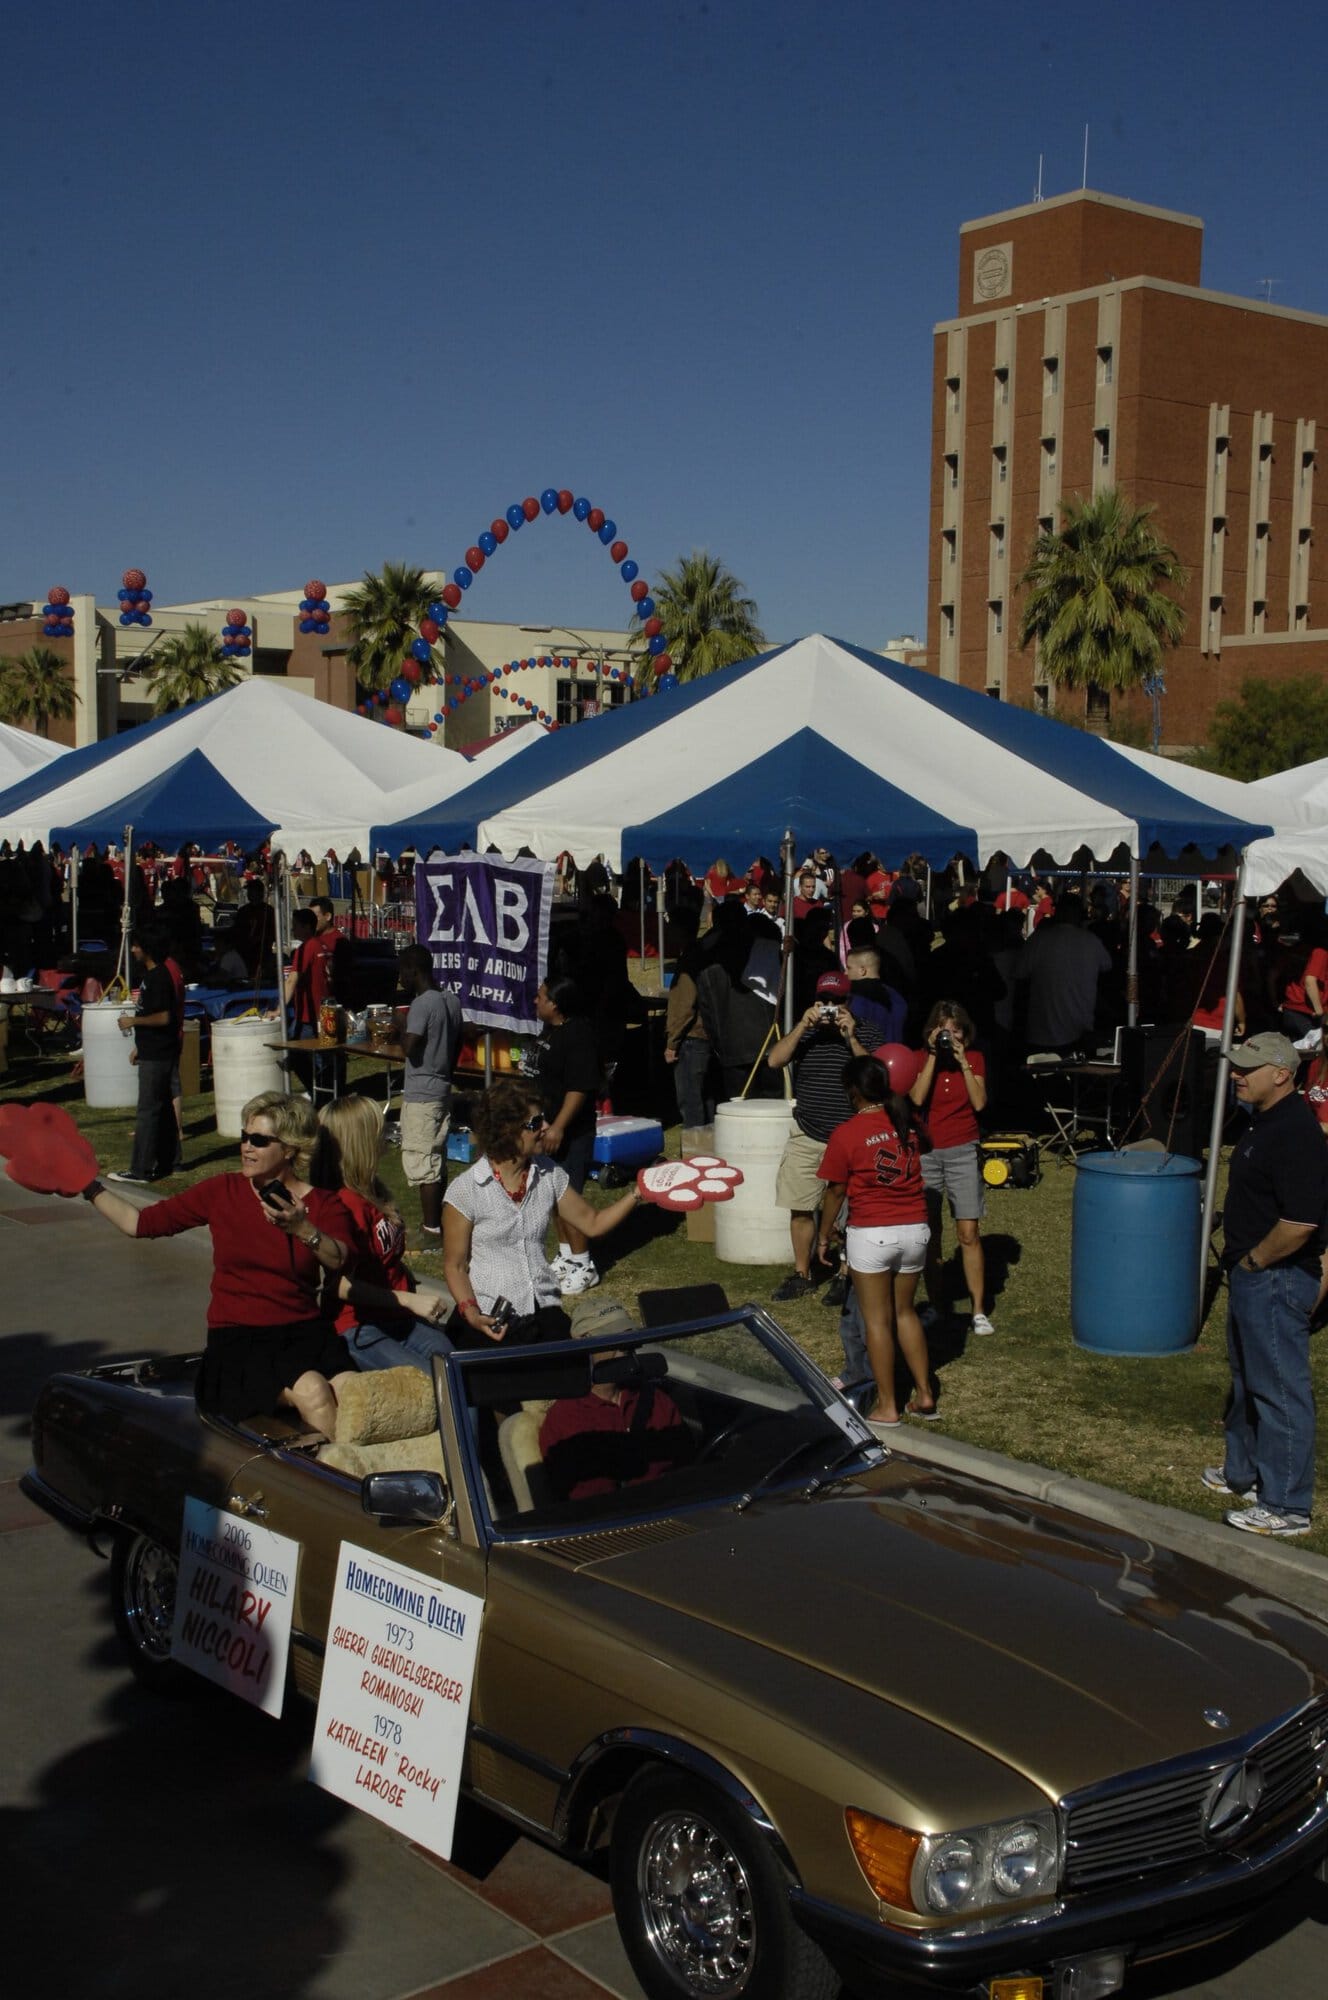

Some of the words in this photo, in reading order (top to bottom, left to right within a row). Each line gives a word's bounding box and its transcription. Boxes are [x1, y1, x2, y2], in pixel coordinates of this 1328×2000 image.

[467, 956, 480, 972] OF
[468, 983, 514, 1005] ALPHA
[186, 1530, 251, 1576] HOMECOMING
[253, 1562, 289, 1593] QUEEN
[224, 1523, 252, 1551] 2006
[189, 1566, 272, 1633] HILARY
[346, 1560, 425, 1617] HOMECOMING
[427, 1594, 466, 1637] QUEEN
[182, 1610, 269, 1684] NICCOLI
[385, 1621, 415, 1651] 1973
[332, 1625, 369, 1659] SHERRI
[371, 1644, 464, 1705] GUENDELSBERGER
[360, 1670, 425, 1719] ROMANOSKI
[326, 1718, 388, 1767] KATHLEEN
[373, 1714, 402, 1745] 1978
[355, 1764, 407, 1808] LAROSE
